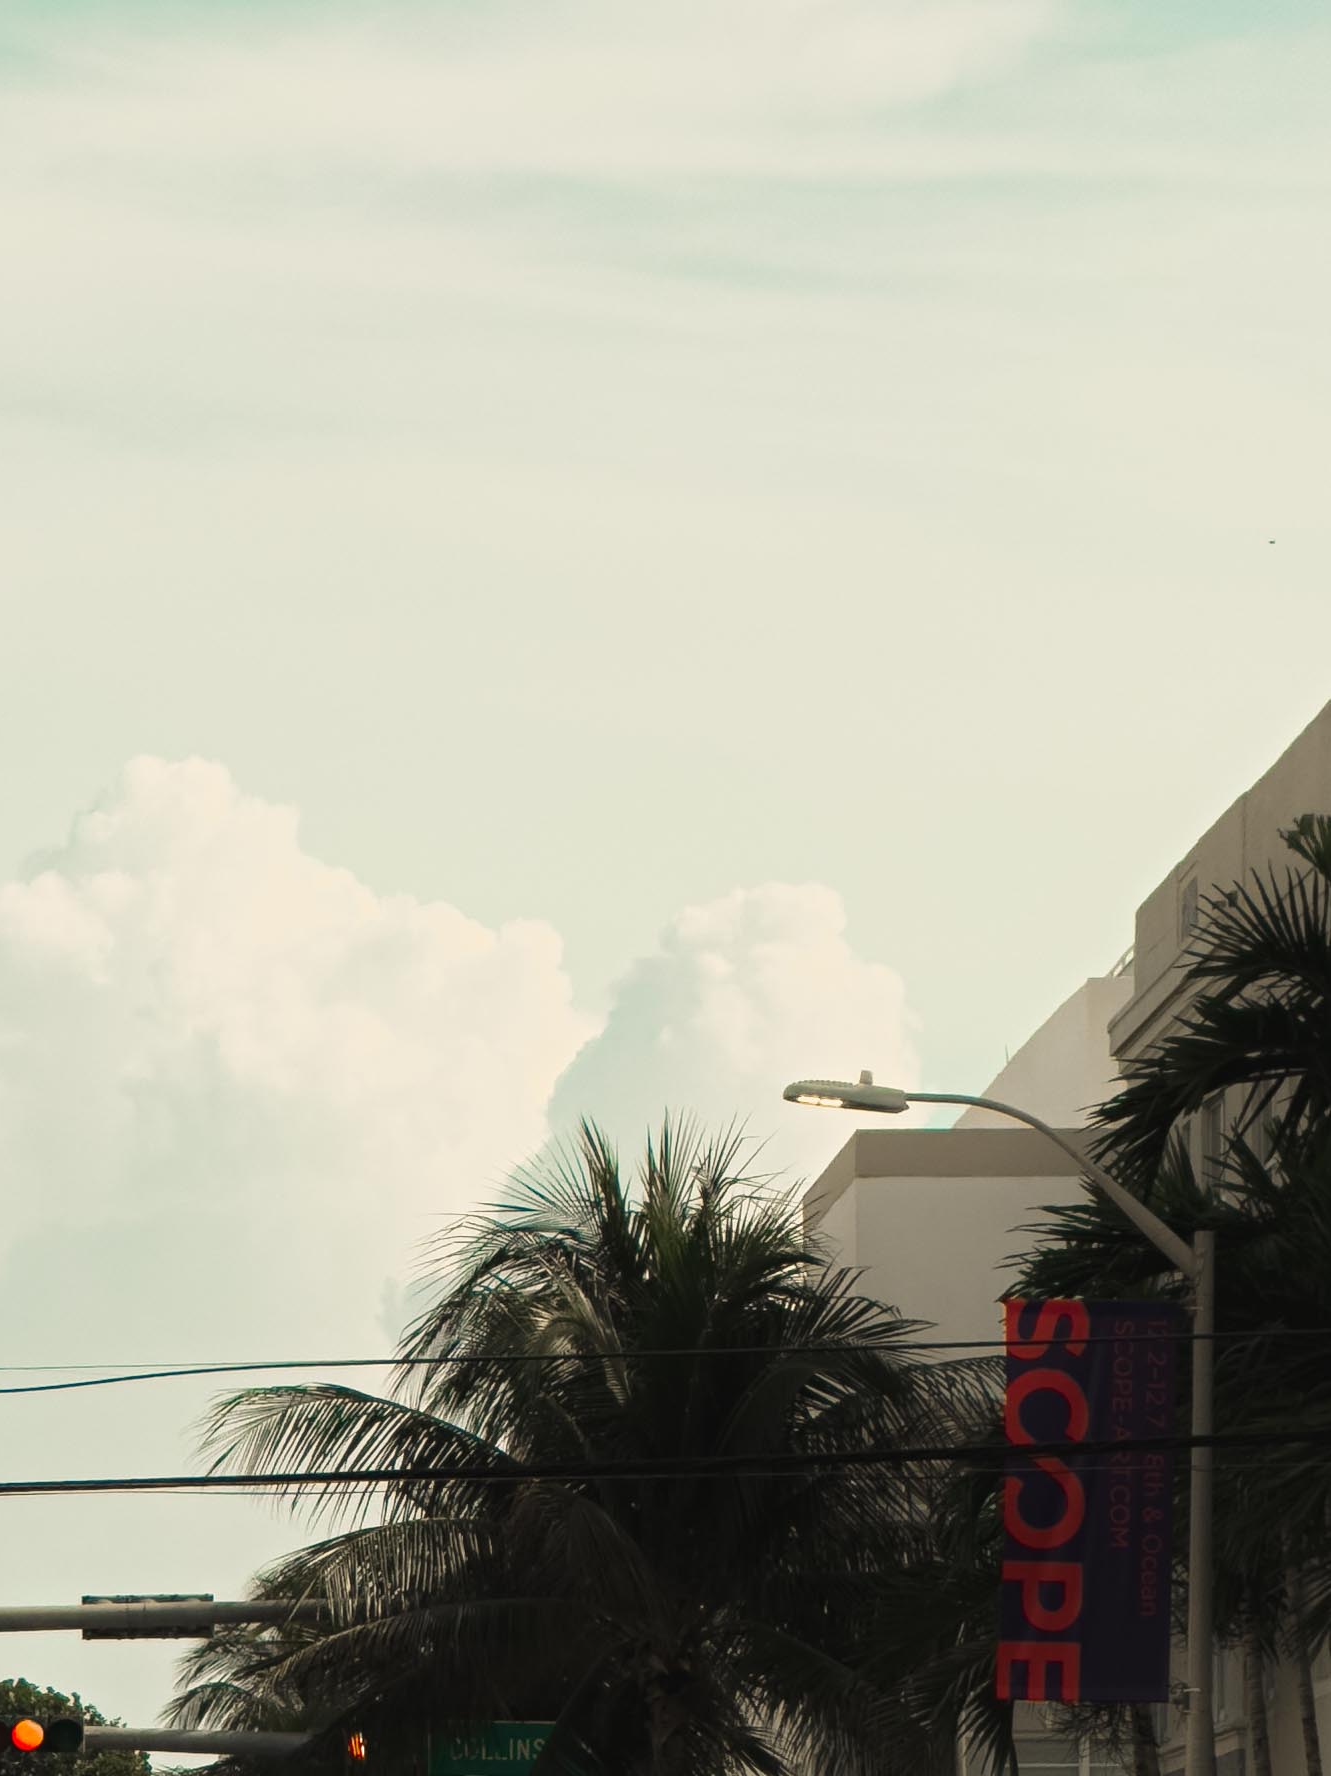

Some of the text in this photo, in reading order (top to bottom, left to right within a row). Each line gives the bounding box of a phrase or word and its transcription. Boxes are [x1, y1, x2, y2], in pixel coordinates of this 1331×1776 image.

[1140, 1503, 1165, 1522] &
[1139, 1534, 1165, 1617] Ocean
[449, 1737, 545, 1761] COLLINS
